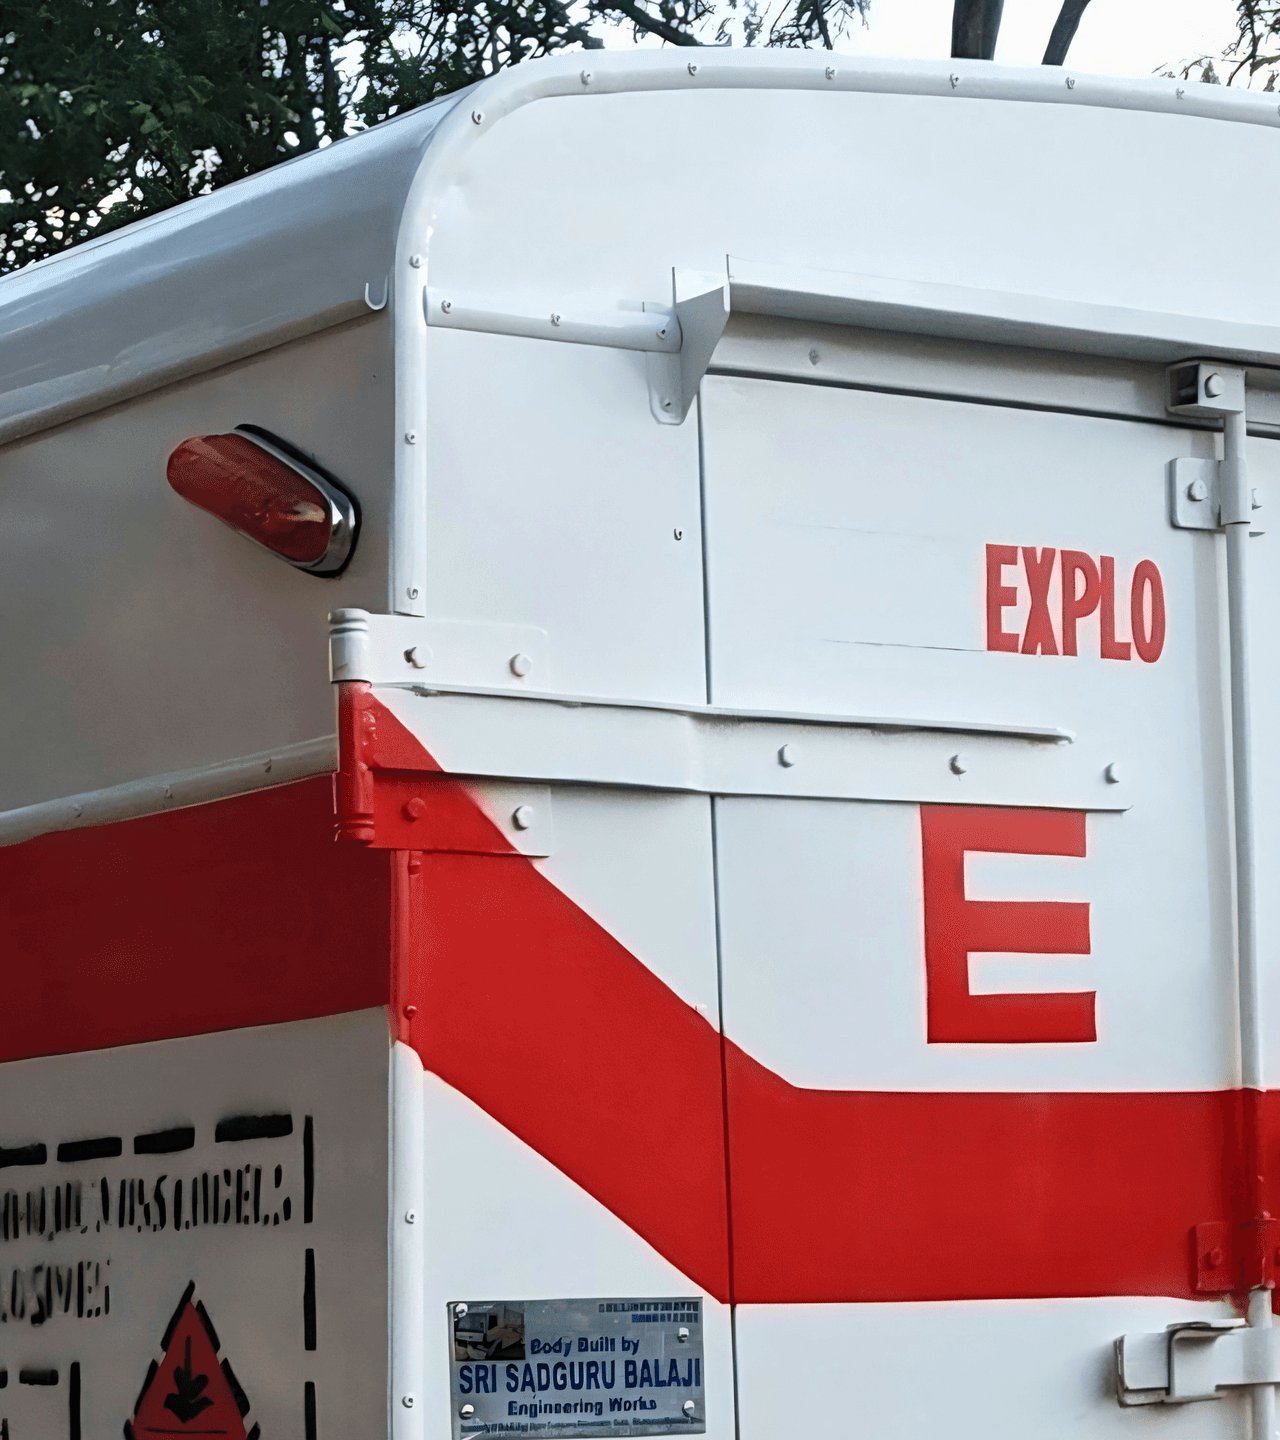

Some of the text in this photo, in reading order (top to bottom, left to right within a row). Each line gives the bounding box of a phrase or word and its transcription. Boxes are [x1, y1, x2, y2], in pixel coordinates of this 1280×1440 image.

[985, 543, 1167, 664] EXPLO
[920, 805, 1098, 1045] E
[459, 1358, 701, 1394] SRI SADGURU BALAJI
[621, 1335, 640, 1355] by
